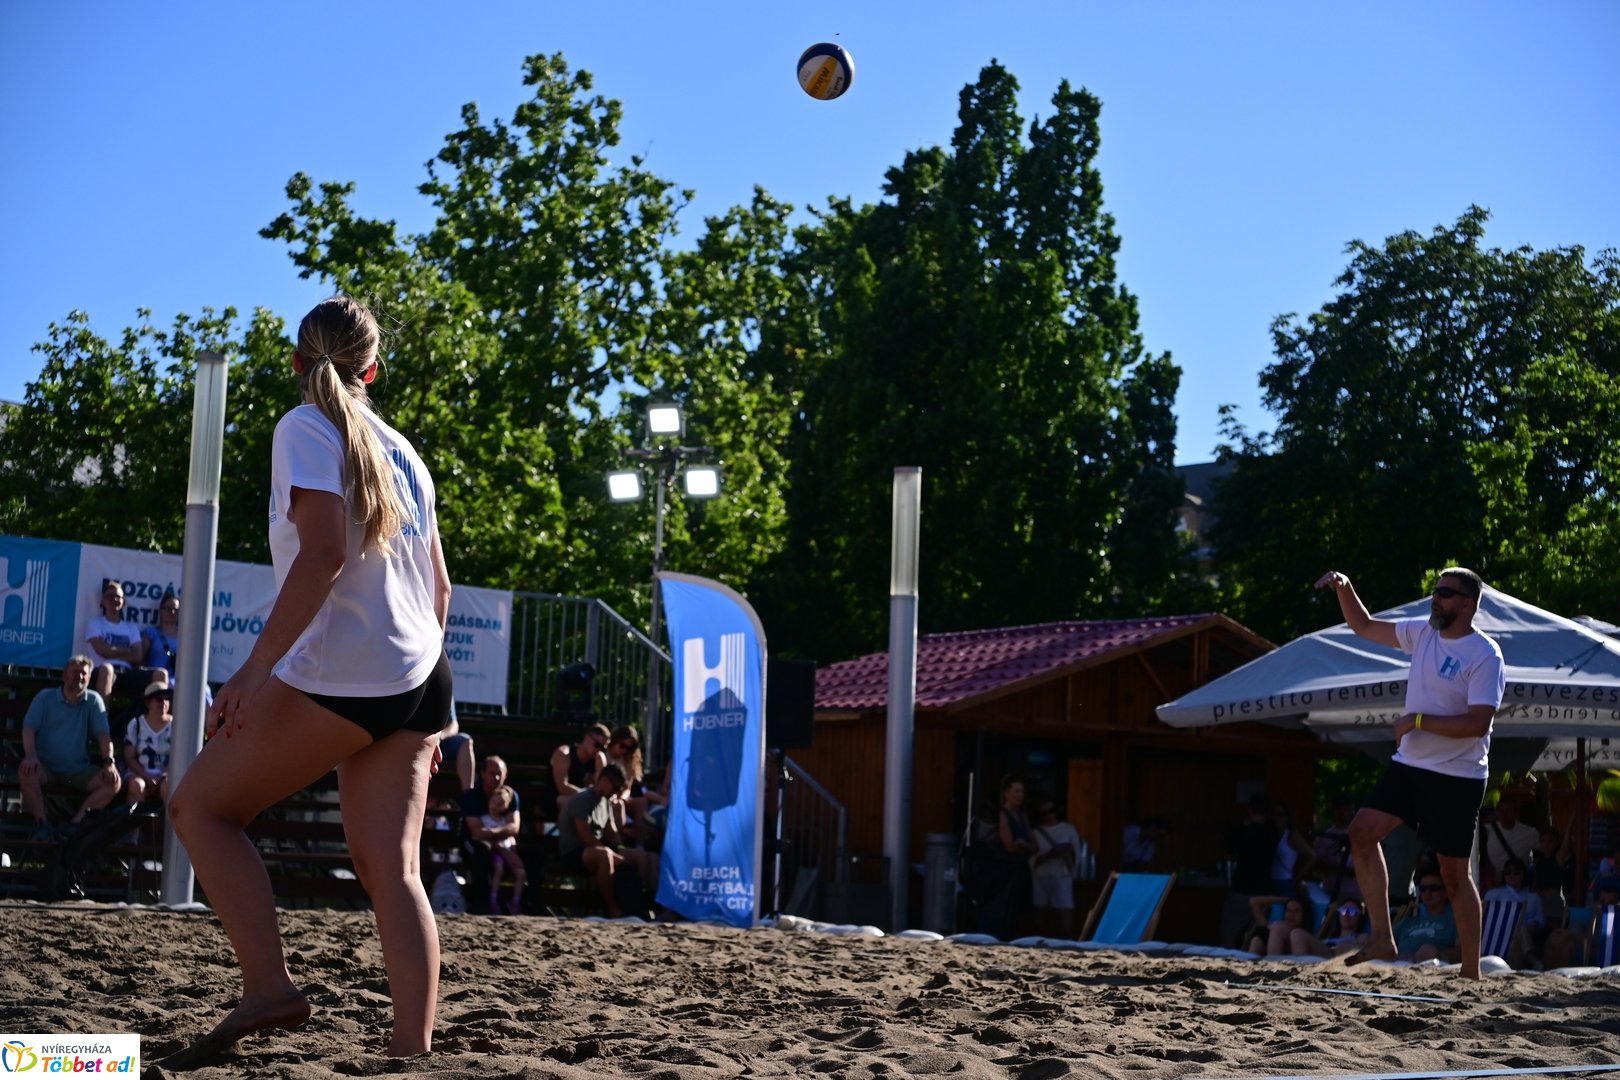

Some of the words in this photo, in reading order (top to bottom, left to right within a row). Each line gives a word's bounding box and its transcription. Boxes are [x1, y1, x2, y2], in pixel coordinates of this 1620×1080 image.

[0, 629, 44, 645] BNER
[1213, 690, 1313, 721] prestito
[692, 866, 739, 879] BEACH
